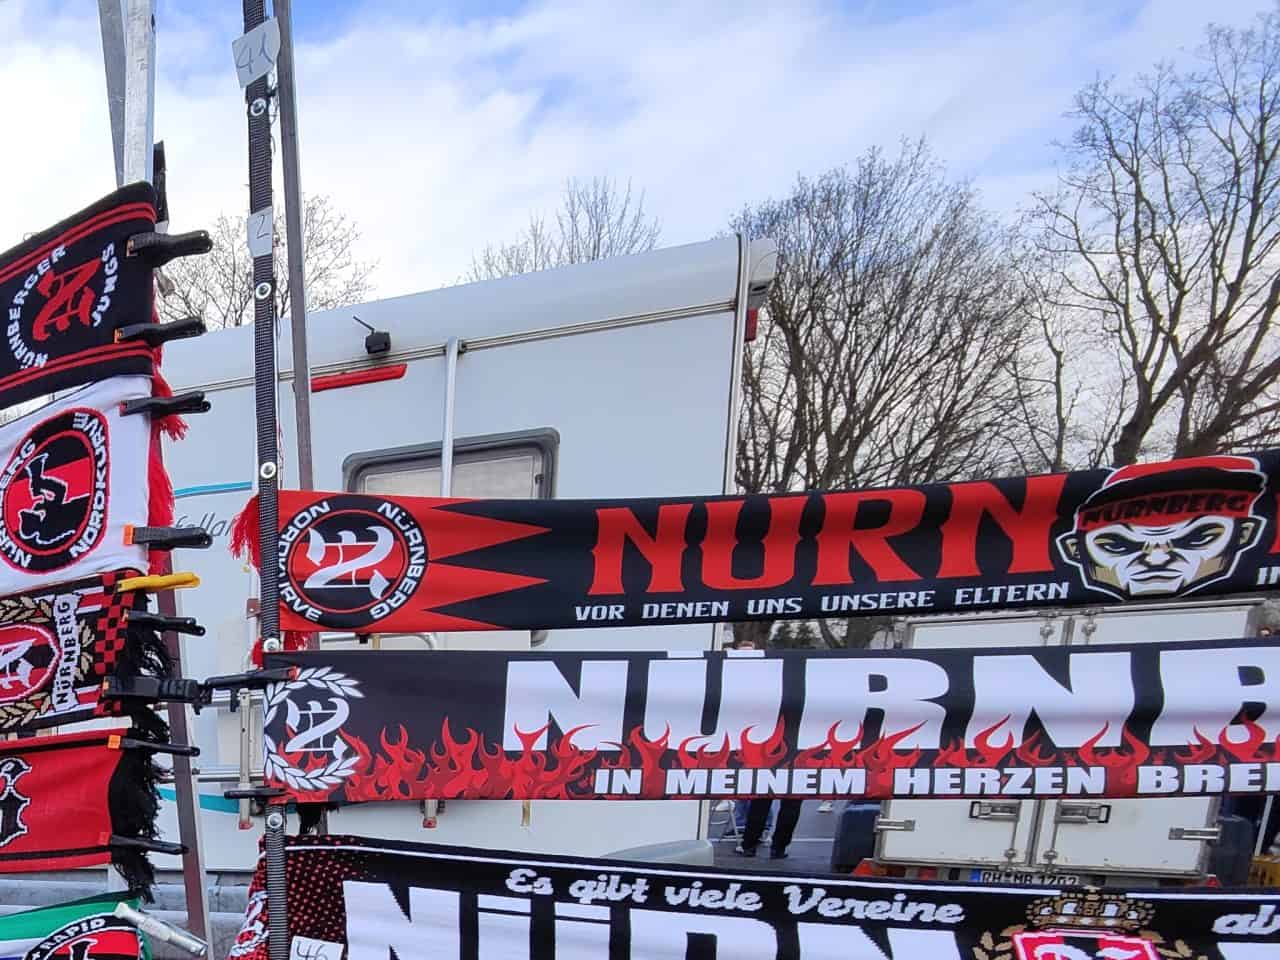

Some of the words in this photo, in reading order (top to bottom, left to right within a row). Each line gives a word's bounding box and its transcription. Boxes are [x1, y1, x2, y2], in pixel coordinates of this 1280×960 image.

[70, 412, 106, 558] NORDKURVE
[370, 502, 425, 619] NÜRNBERG
[575, 604, 624, 622] VOR
[641, 601, 729, 619] DENEN
[747, 597, 802, 615] UNS
[821, 590, 934, 611] UNSERE
[954, 581, 1070, 604] ELTERN
[56, 601, 72, 705] NÜRNBERG
[593, 767, 643, 795] IN
[664, 766, 868, 796] MEINEM
[893, 765, 1107, 796] HERZEN
[506, 869, 553, 895] Es
[569, 873, 650, 906] gibt
[665, 881, 763, 913] viele
[785, 884, 965, 924] Vereine
[40, 918, 106, 949] RAPID
